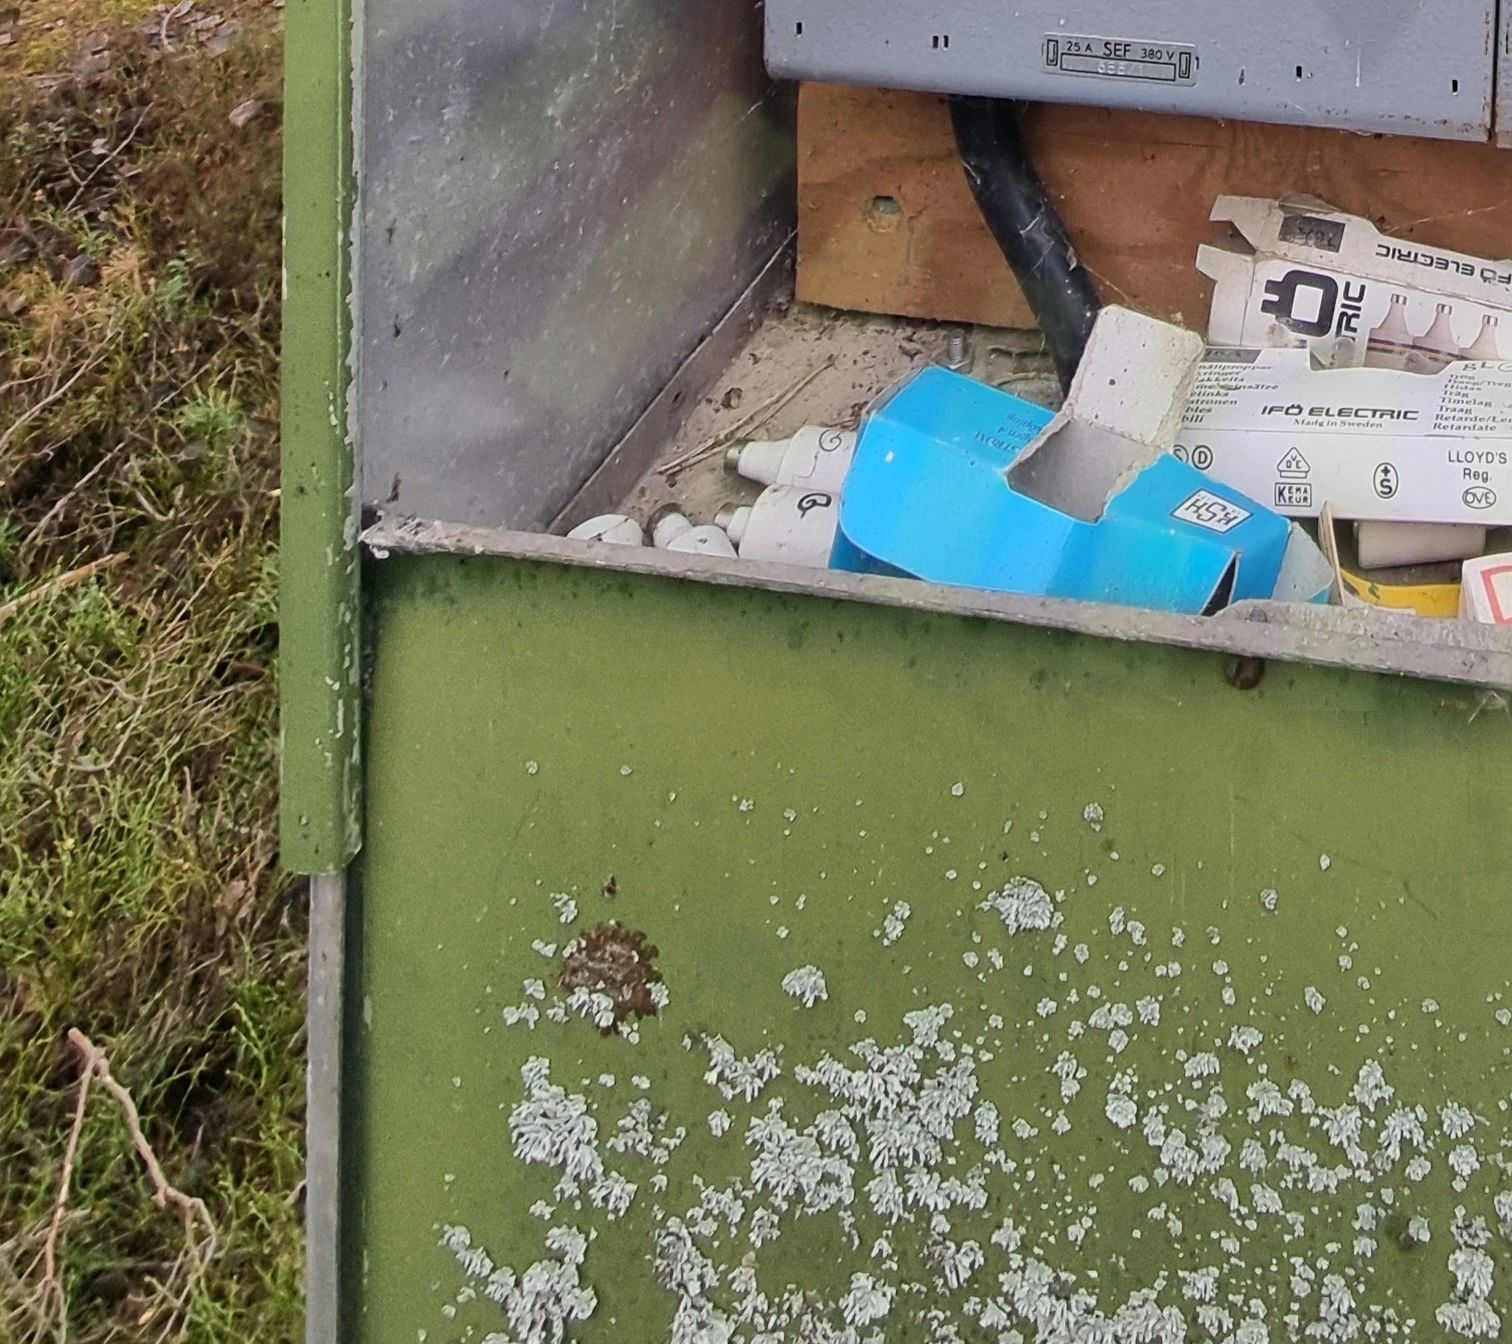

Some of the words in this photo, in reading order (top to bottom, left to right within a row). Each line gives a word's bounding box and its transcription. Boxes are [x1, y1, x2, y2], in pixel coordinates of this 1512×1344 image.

[1066, 41, 1081, 52] 25
[1085, 43, 1093, 53] A
[1103, 41, 1132, 58] SEF
[1141, 48, 1163, 60] 380
[1166, 51, 1176, 61] V
[1376, 243, 1476, 277] ELECTRIC
[1261, 404, 1303, 416] IFÖ
[1308, 406, 1419, 421] ELECTRIC
[1448, 450, 1507, 465] LLOYD'S
[1463, 468, 1492, 483] Reg.
